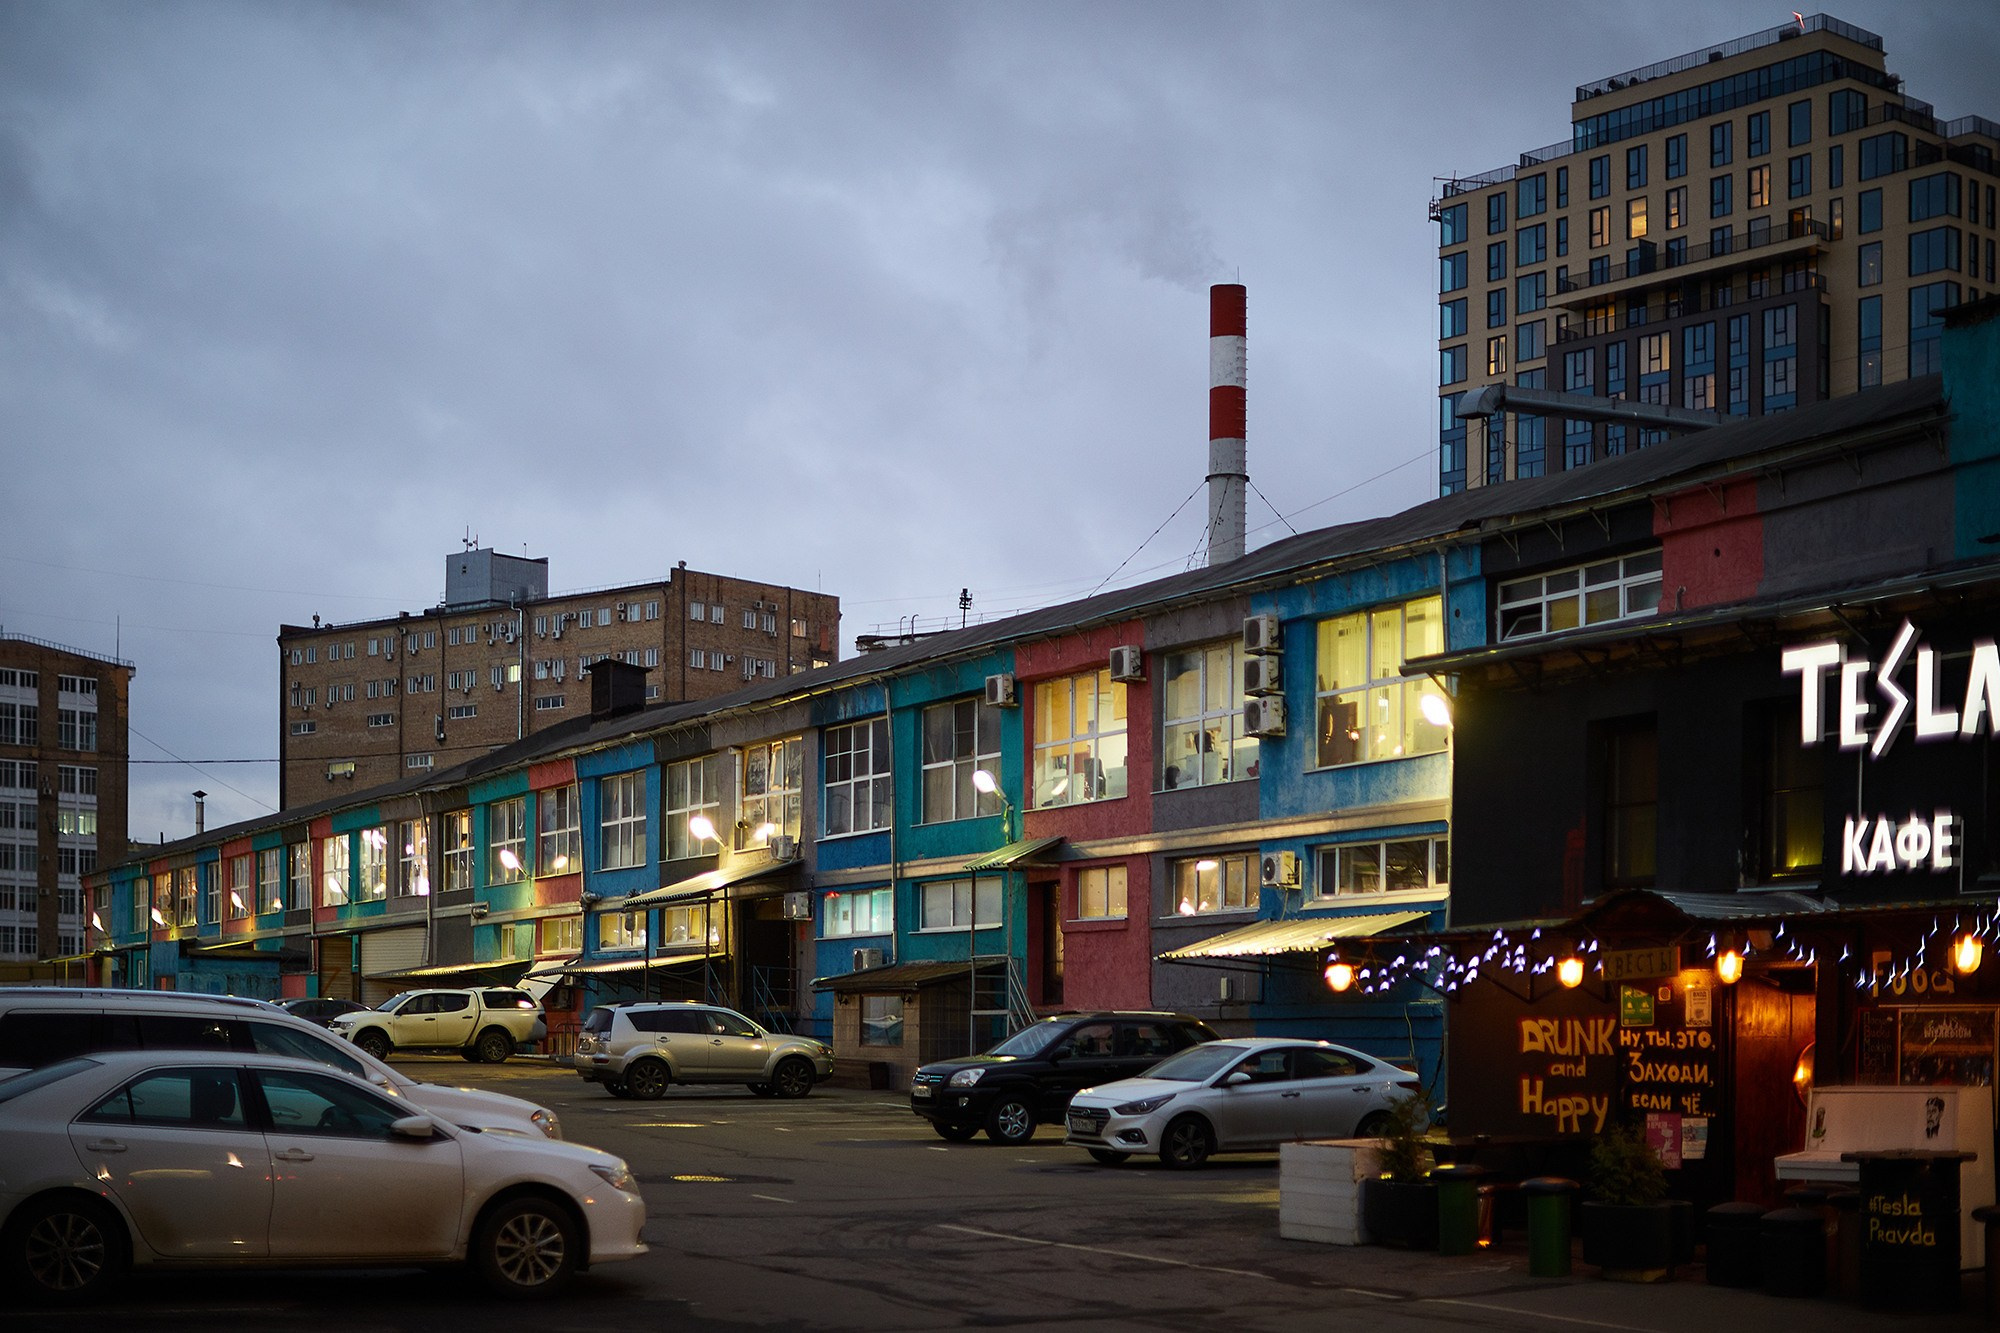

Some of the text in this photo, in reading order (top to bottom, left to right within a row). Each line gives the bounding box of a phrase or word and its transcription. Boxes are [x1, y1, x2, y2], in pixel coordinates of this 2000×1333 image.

[1781, 619, 2000, 757] TESLA
[1842, 813, 1953, 872] КАФЕ
[1871, 947, 1956, 998] Food
[1521, 1018, 1617, 1056] DRUNK
[1550, 1056, 1587, 1078] and
[1868, 1193, 1923, 1216] #Tesla
